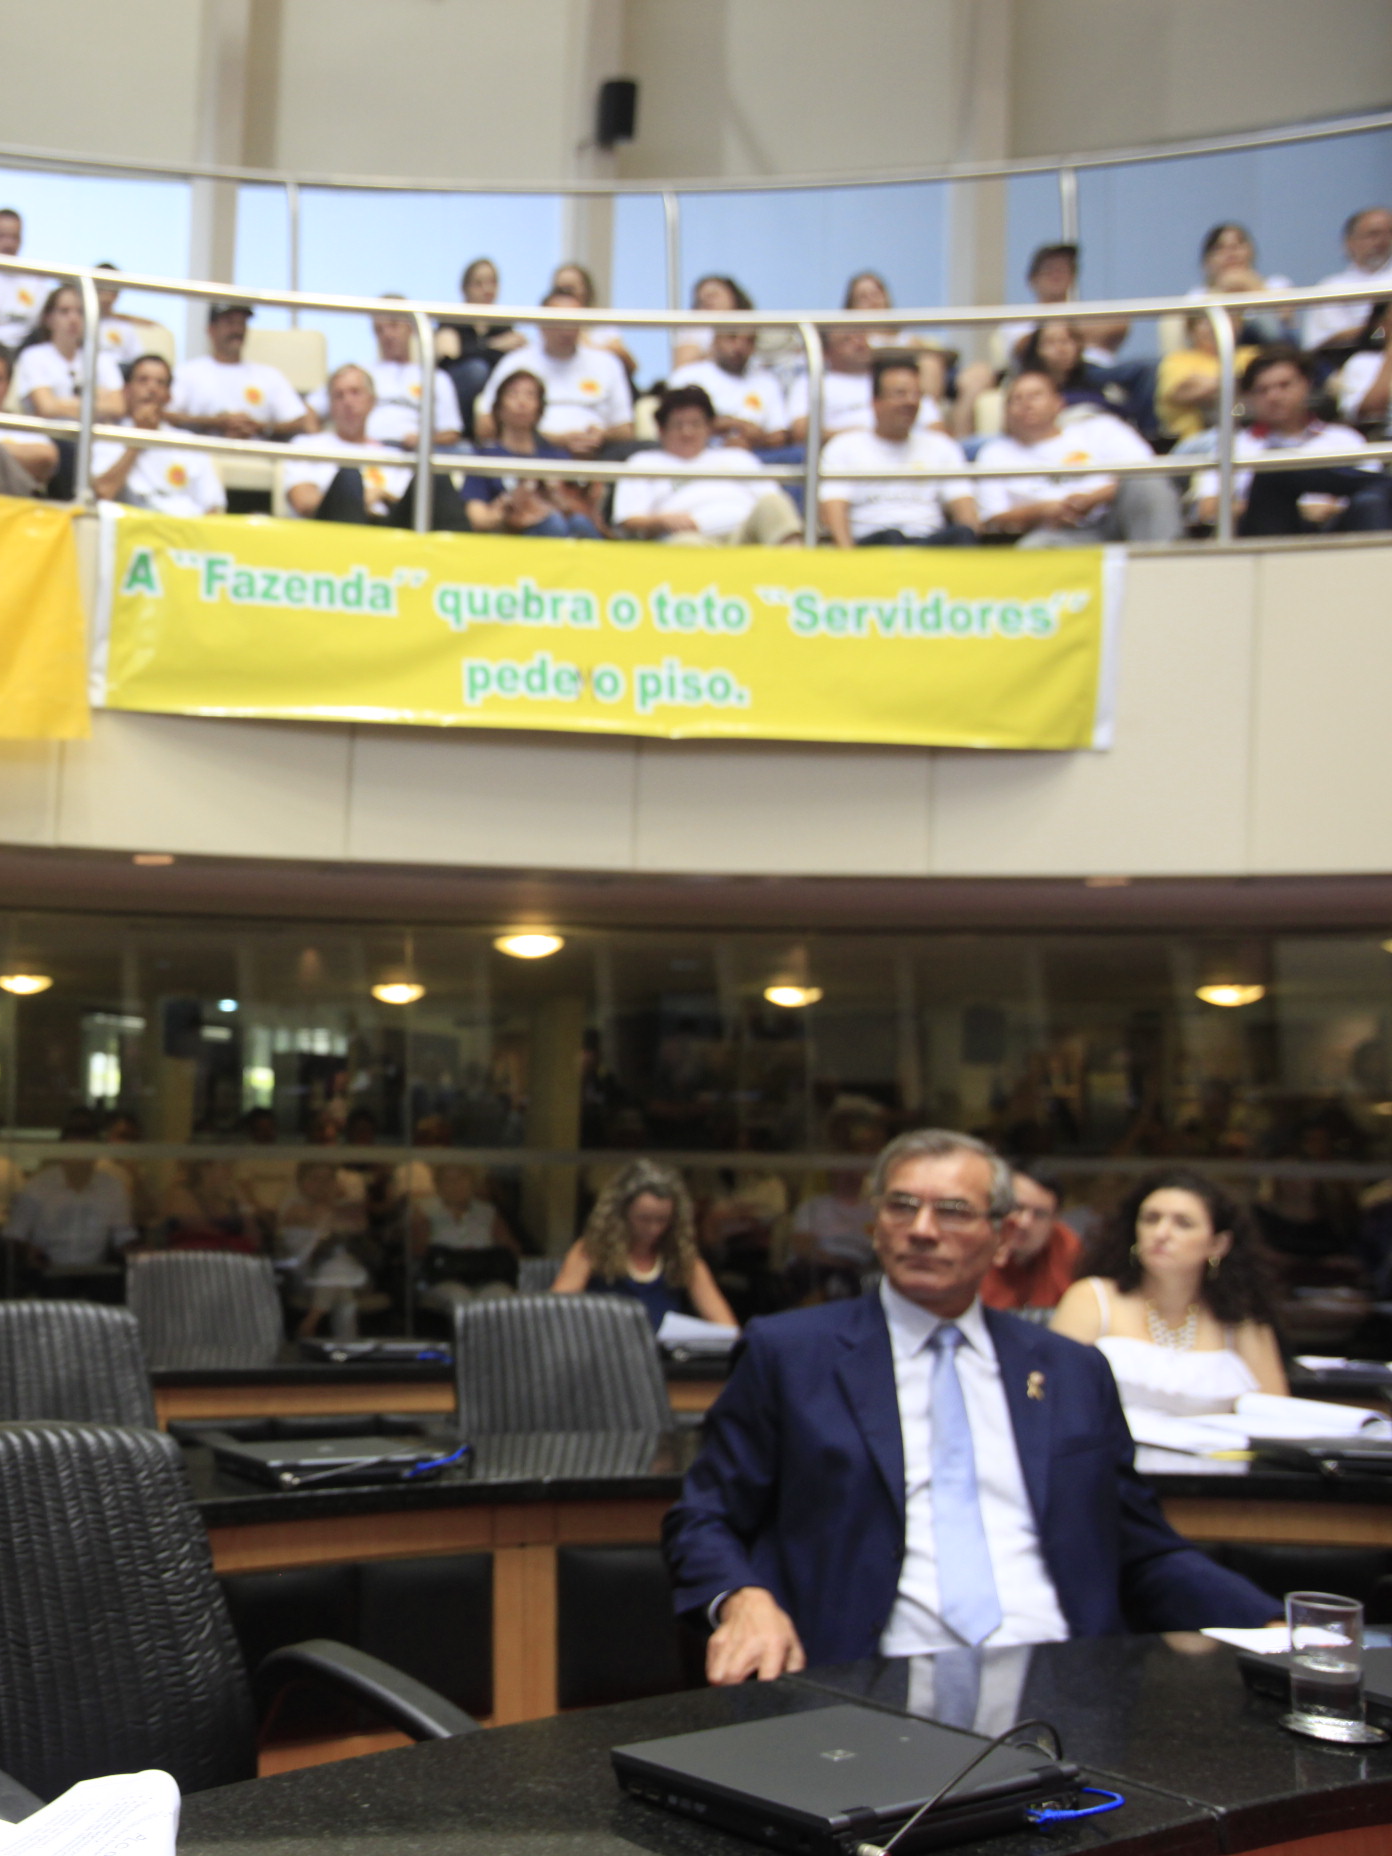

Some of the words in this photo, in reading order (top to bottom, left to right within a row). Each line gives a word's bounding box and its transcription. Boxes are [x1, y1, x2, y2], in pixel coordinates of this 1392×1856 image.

[122, 550, 159, 594] A
[437, 582, 595, 630] quebra
[610, 595, 638, 626] o
[652, 589, 748, 629] teto
[465, 656, 581, 702] pede
[593, 668, 621, 698] o
[638, 662, 748, 711] piso.
